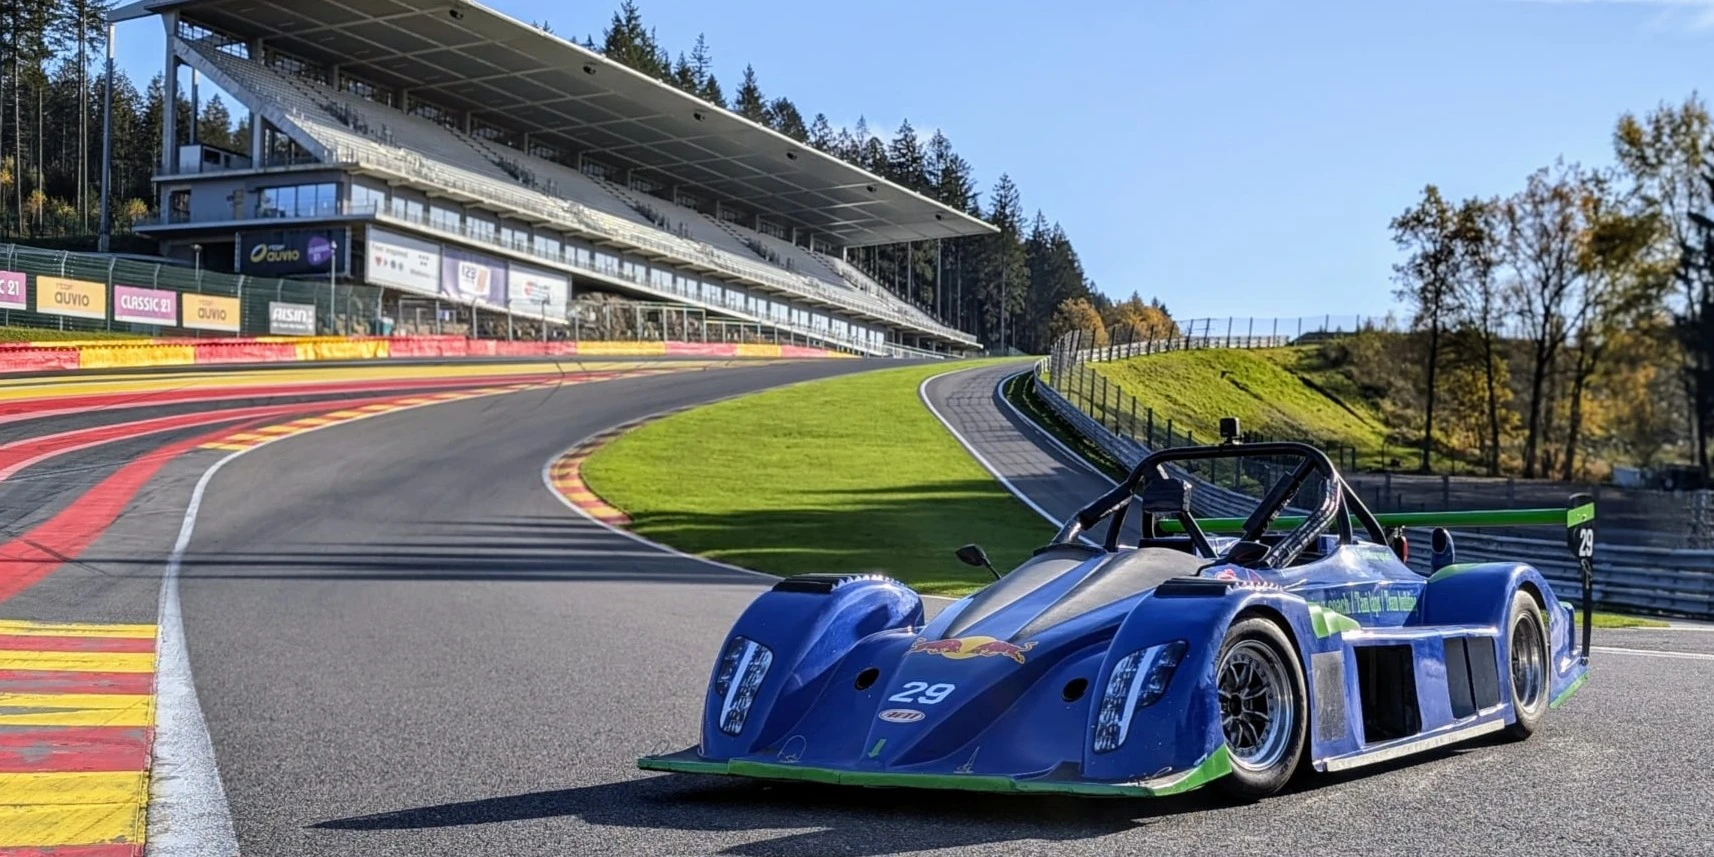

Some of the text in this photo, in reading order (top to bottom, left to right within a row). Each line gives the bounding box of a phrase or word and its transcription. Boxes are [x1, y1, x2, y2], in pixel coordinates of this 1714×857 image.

[7, 279, 19, 296] 21
[54, 291, 90, 307] auvio
[121, 295, 171, 313] CLASSIC 21
[197, 307, 227, 321] auvio
[1579, 528, 1594, 557] 29
[887, 681, 956, 705] 29
